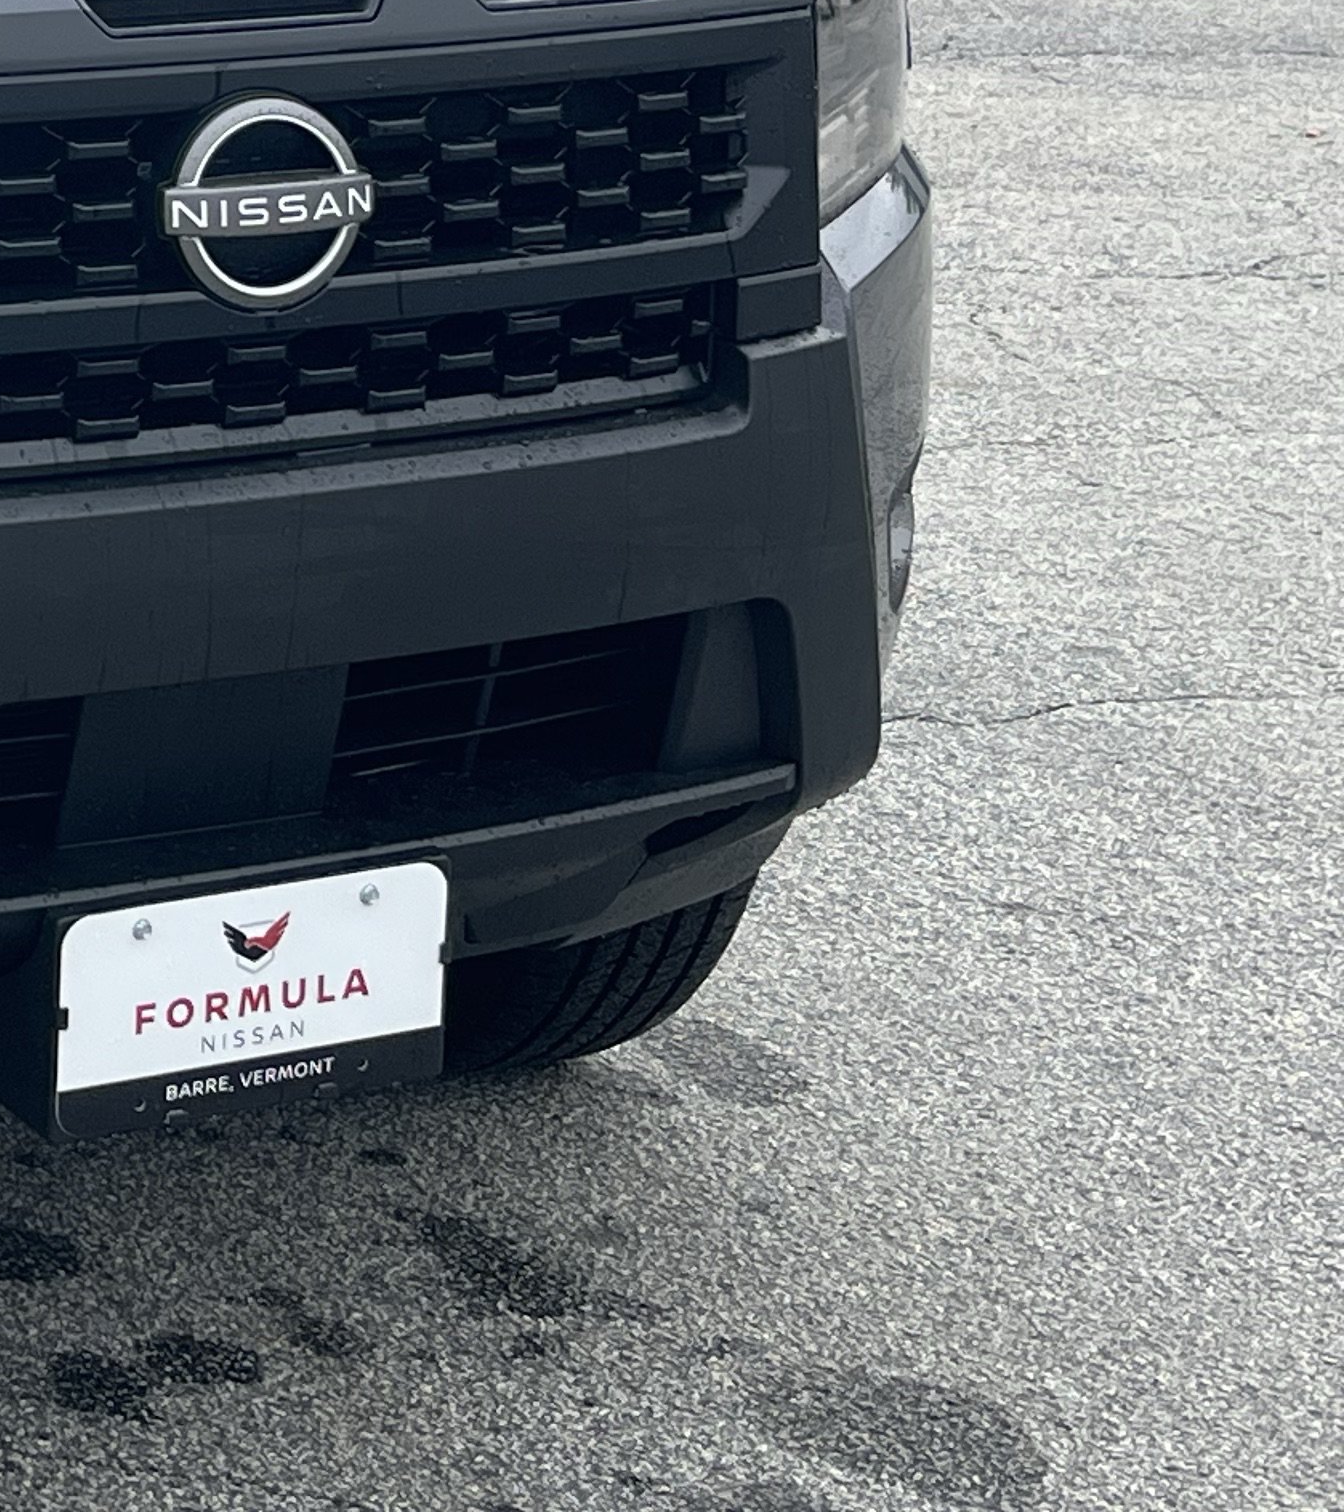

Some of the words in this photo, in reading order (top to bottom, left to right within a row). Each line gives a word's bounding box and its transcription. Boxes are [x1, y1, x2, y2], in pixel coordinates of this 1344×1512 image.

[171, 184, 372, 229] NISSAN
[134, 968, 370, 1035] FORMULA
[200, 1020, 305, 1054] NISSAN
[165, 1075, 235, 1102] BARRE,
[239, 1056, 337, 1089] VERMONT
